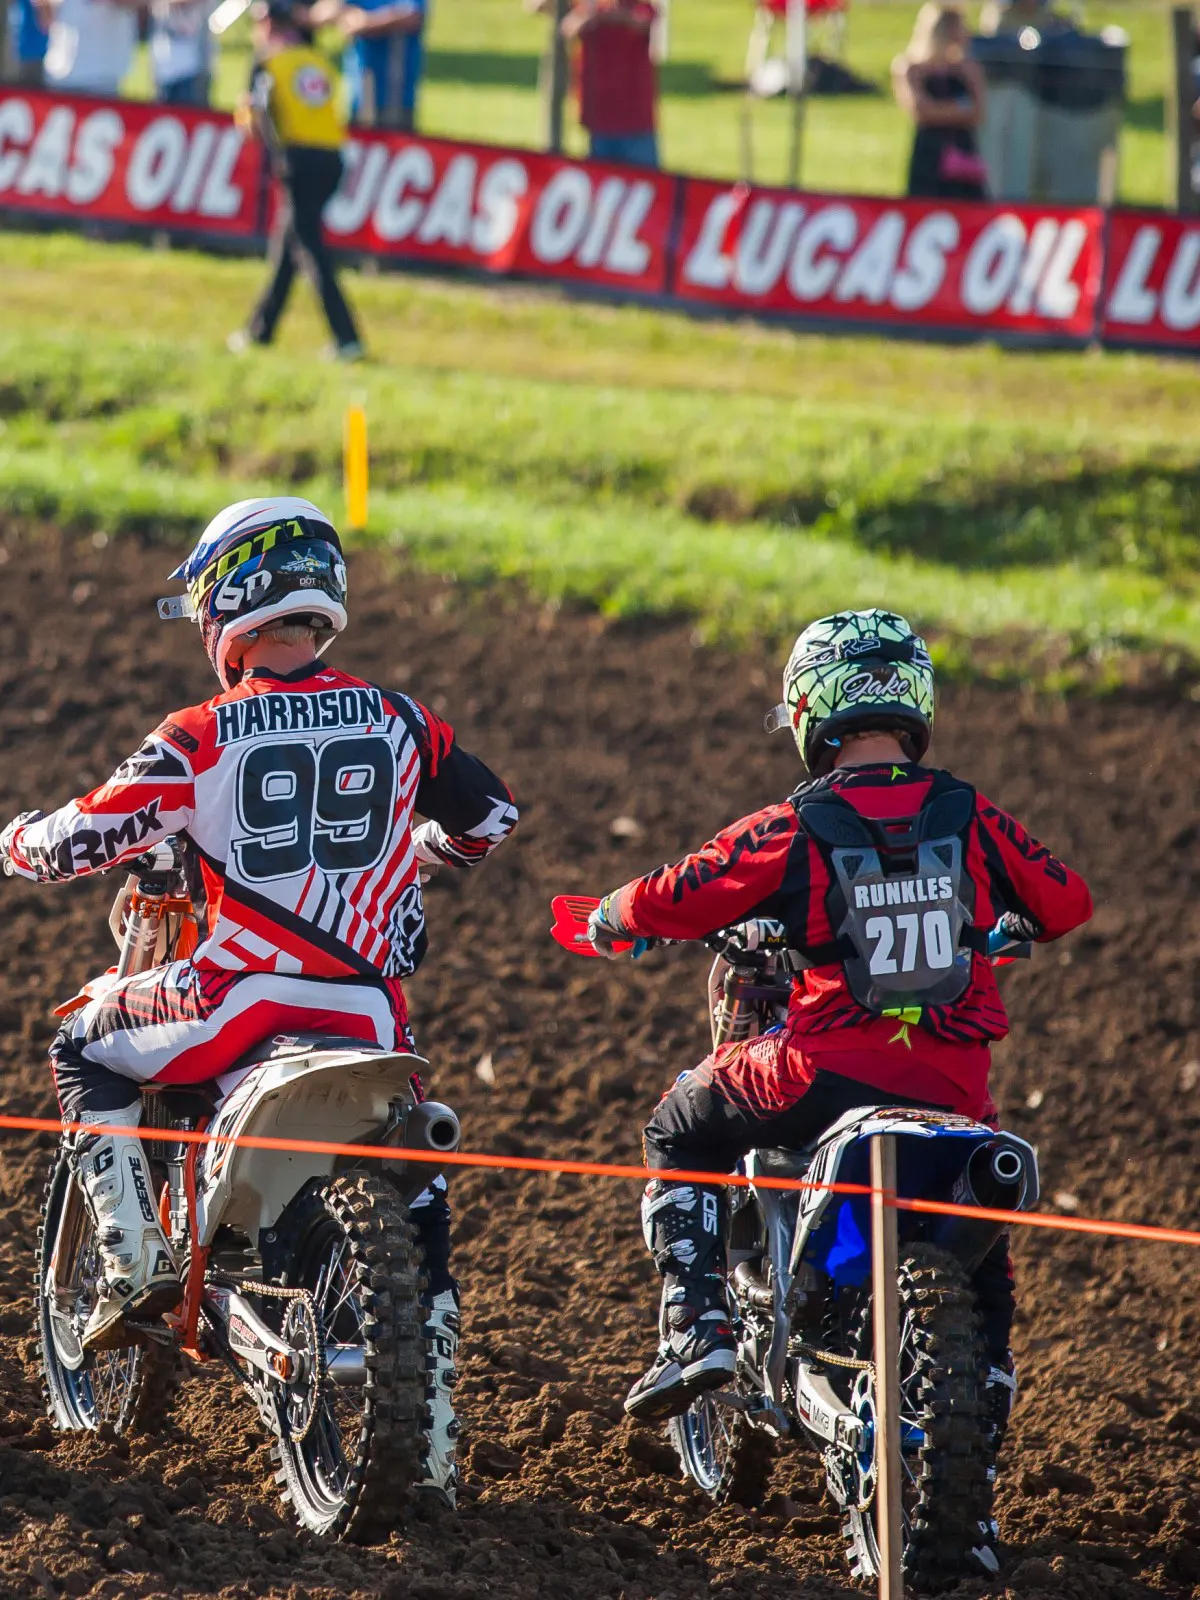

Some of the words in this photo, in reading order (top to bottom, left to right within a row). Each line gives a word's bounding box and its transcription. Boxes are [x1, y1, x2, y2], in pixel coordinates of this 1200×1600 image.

[127, 115, 244, 218] OIL
[321, 138, 529, 256] UCAS
[530, 168, 657, 277] OIL
[684, 193, 960, 312] LUCAS
[961, 214, 1089, 320] OIL
[300, 577, 316, 585] DOT
[214, 688, 385, 746] HARRISON
[843, 672, 910, 701] Jake
[232, 734, 397, 883] 99
[854, 876, 953, 908] RUNKLES
[866, 910, 953, 975] 270
